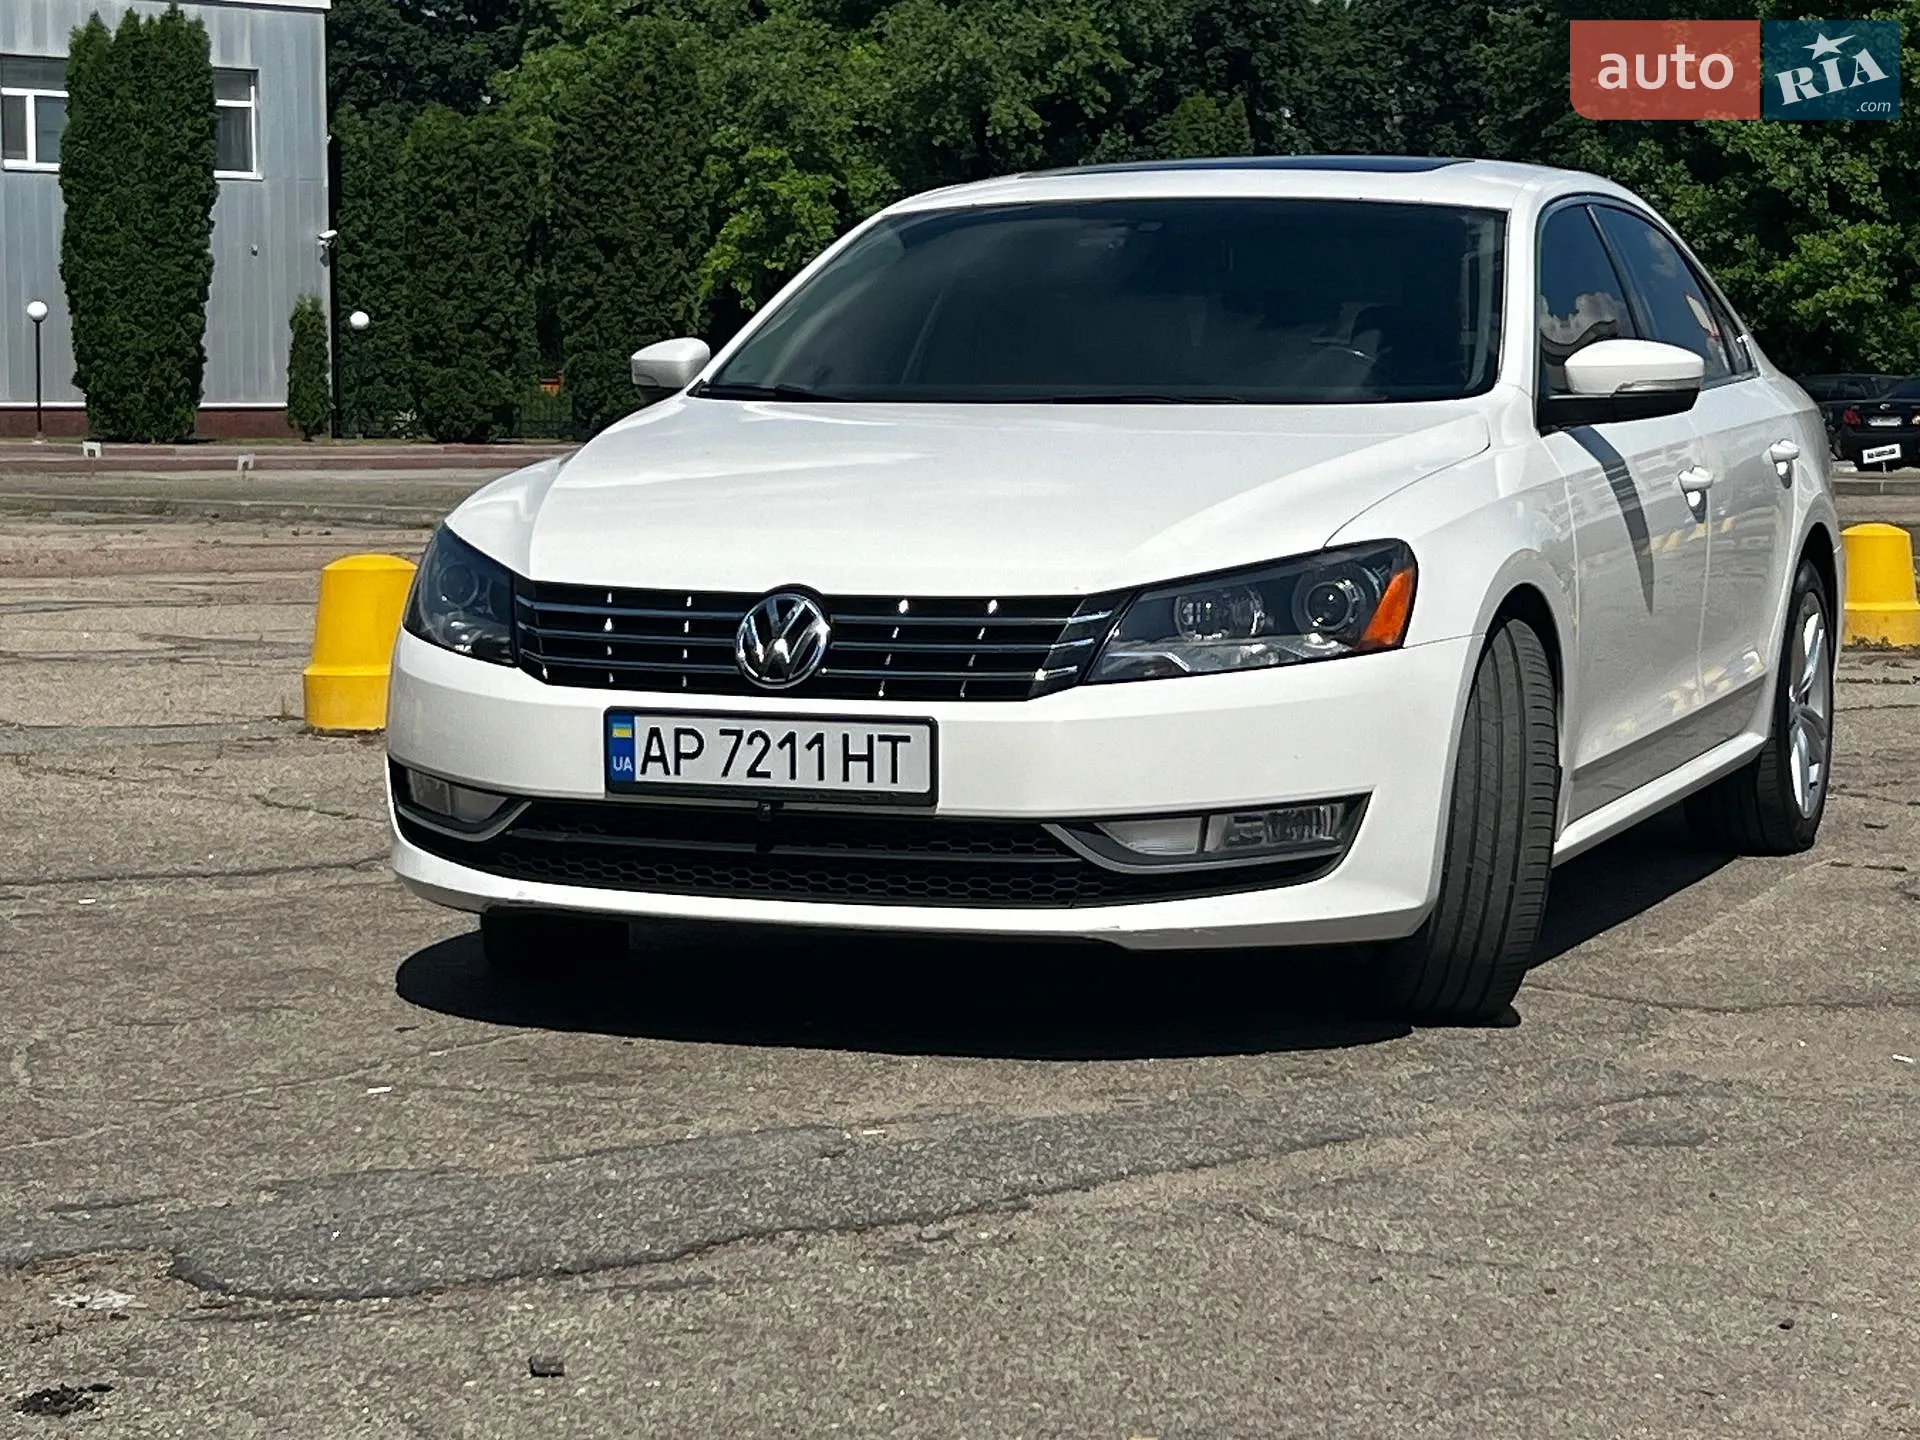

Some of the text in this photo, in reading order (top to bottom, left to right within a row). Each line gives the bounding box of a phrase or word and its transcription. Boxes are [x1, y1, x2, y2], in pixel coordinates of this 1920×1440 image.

[612, 755, 633, 772] UA
[640, 726, 911, 784] AP 7211 HT
